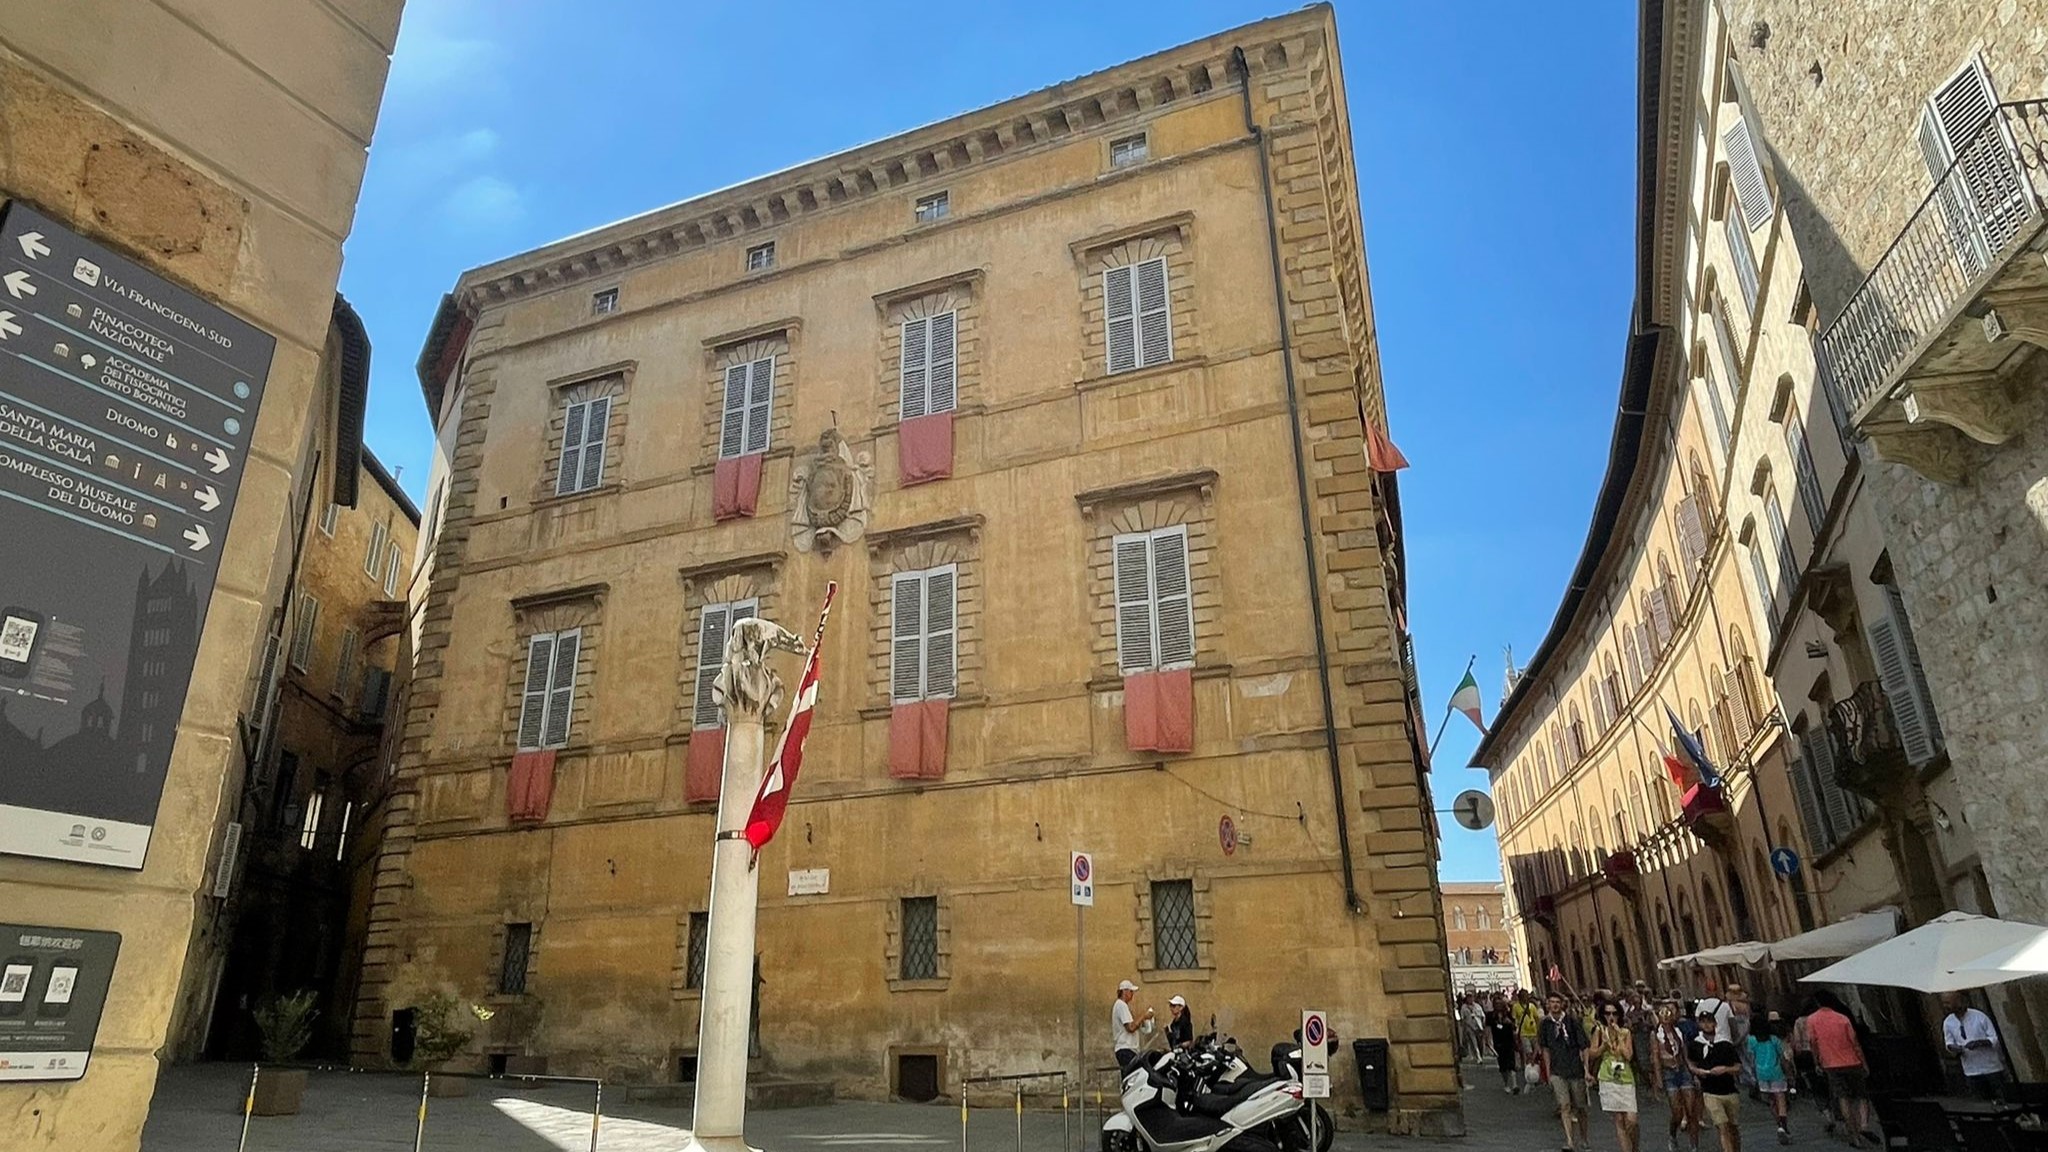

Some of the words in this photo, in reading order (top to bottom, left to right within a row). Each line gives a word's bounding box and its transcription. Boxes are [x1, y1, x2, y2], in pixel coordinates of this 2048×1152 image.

[92, 307, 175, 355] PINACOTECA
[104, 275, 126, 297] VIA
[128, 289, 206, 337] FRANCIGENA
[208, 330, 232, 349] SUD
[88, 319, 165, 362] NAZIONALE
[103, 365, 122, 380] DEI
[124, 374, 187, 408] FISIOCRITICI
[106, 356, 170, 391] ACCADEMIA
[100, 375, 131, 395] ORTO
[133, 389, 186, 419] BOTANICO
[0, 404, 46, 432] SANTA
[49, 424, 96, 452] MARIA
[0, 420, 44, 447] DELLA
[46, 437, 93, 465] SCALA
[105, 408, 159, 439] DUOMO
[0, 454, 74, 489] OMPLESSO
[75, 481, 138, 513] MUSEALE
[47, 487, 76, 505] DEL
[78, 497, 134, 526] DUOMO
